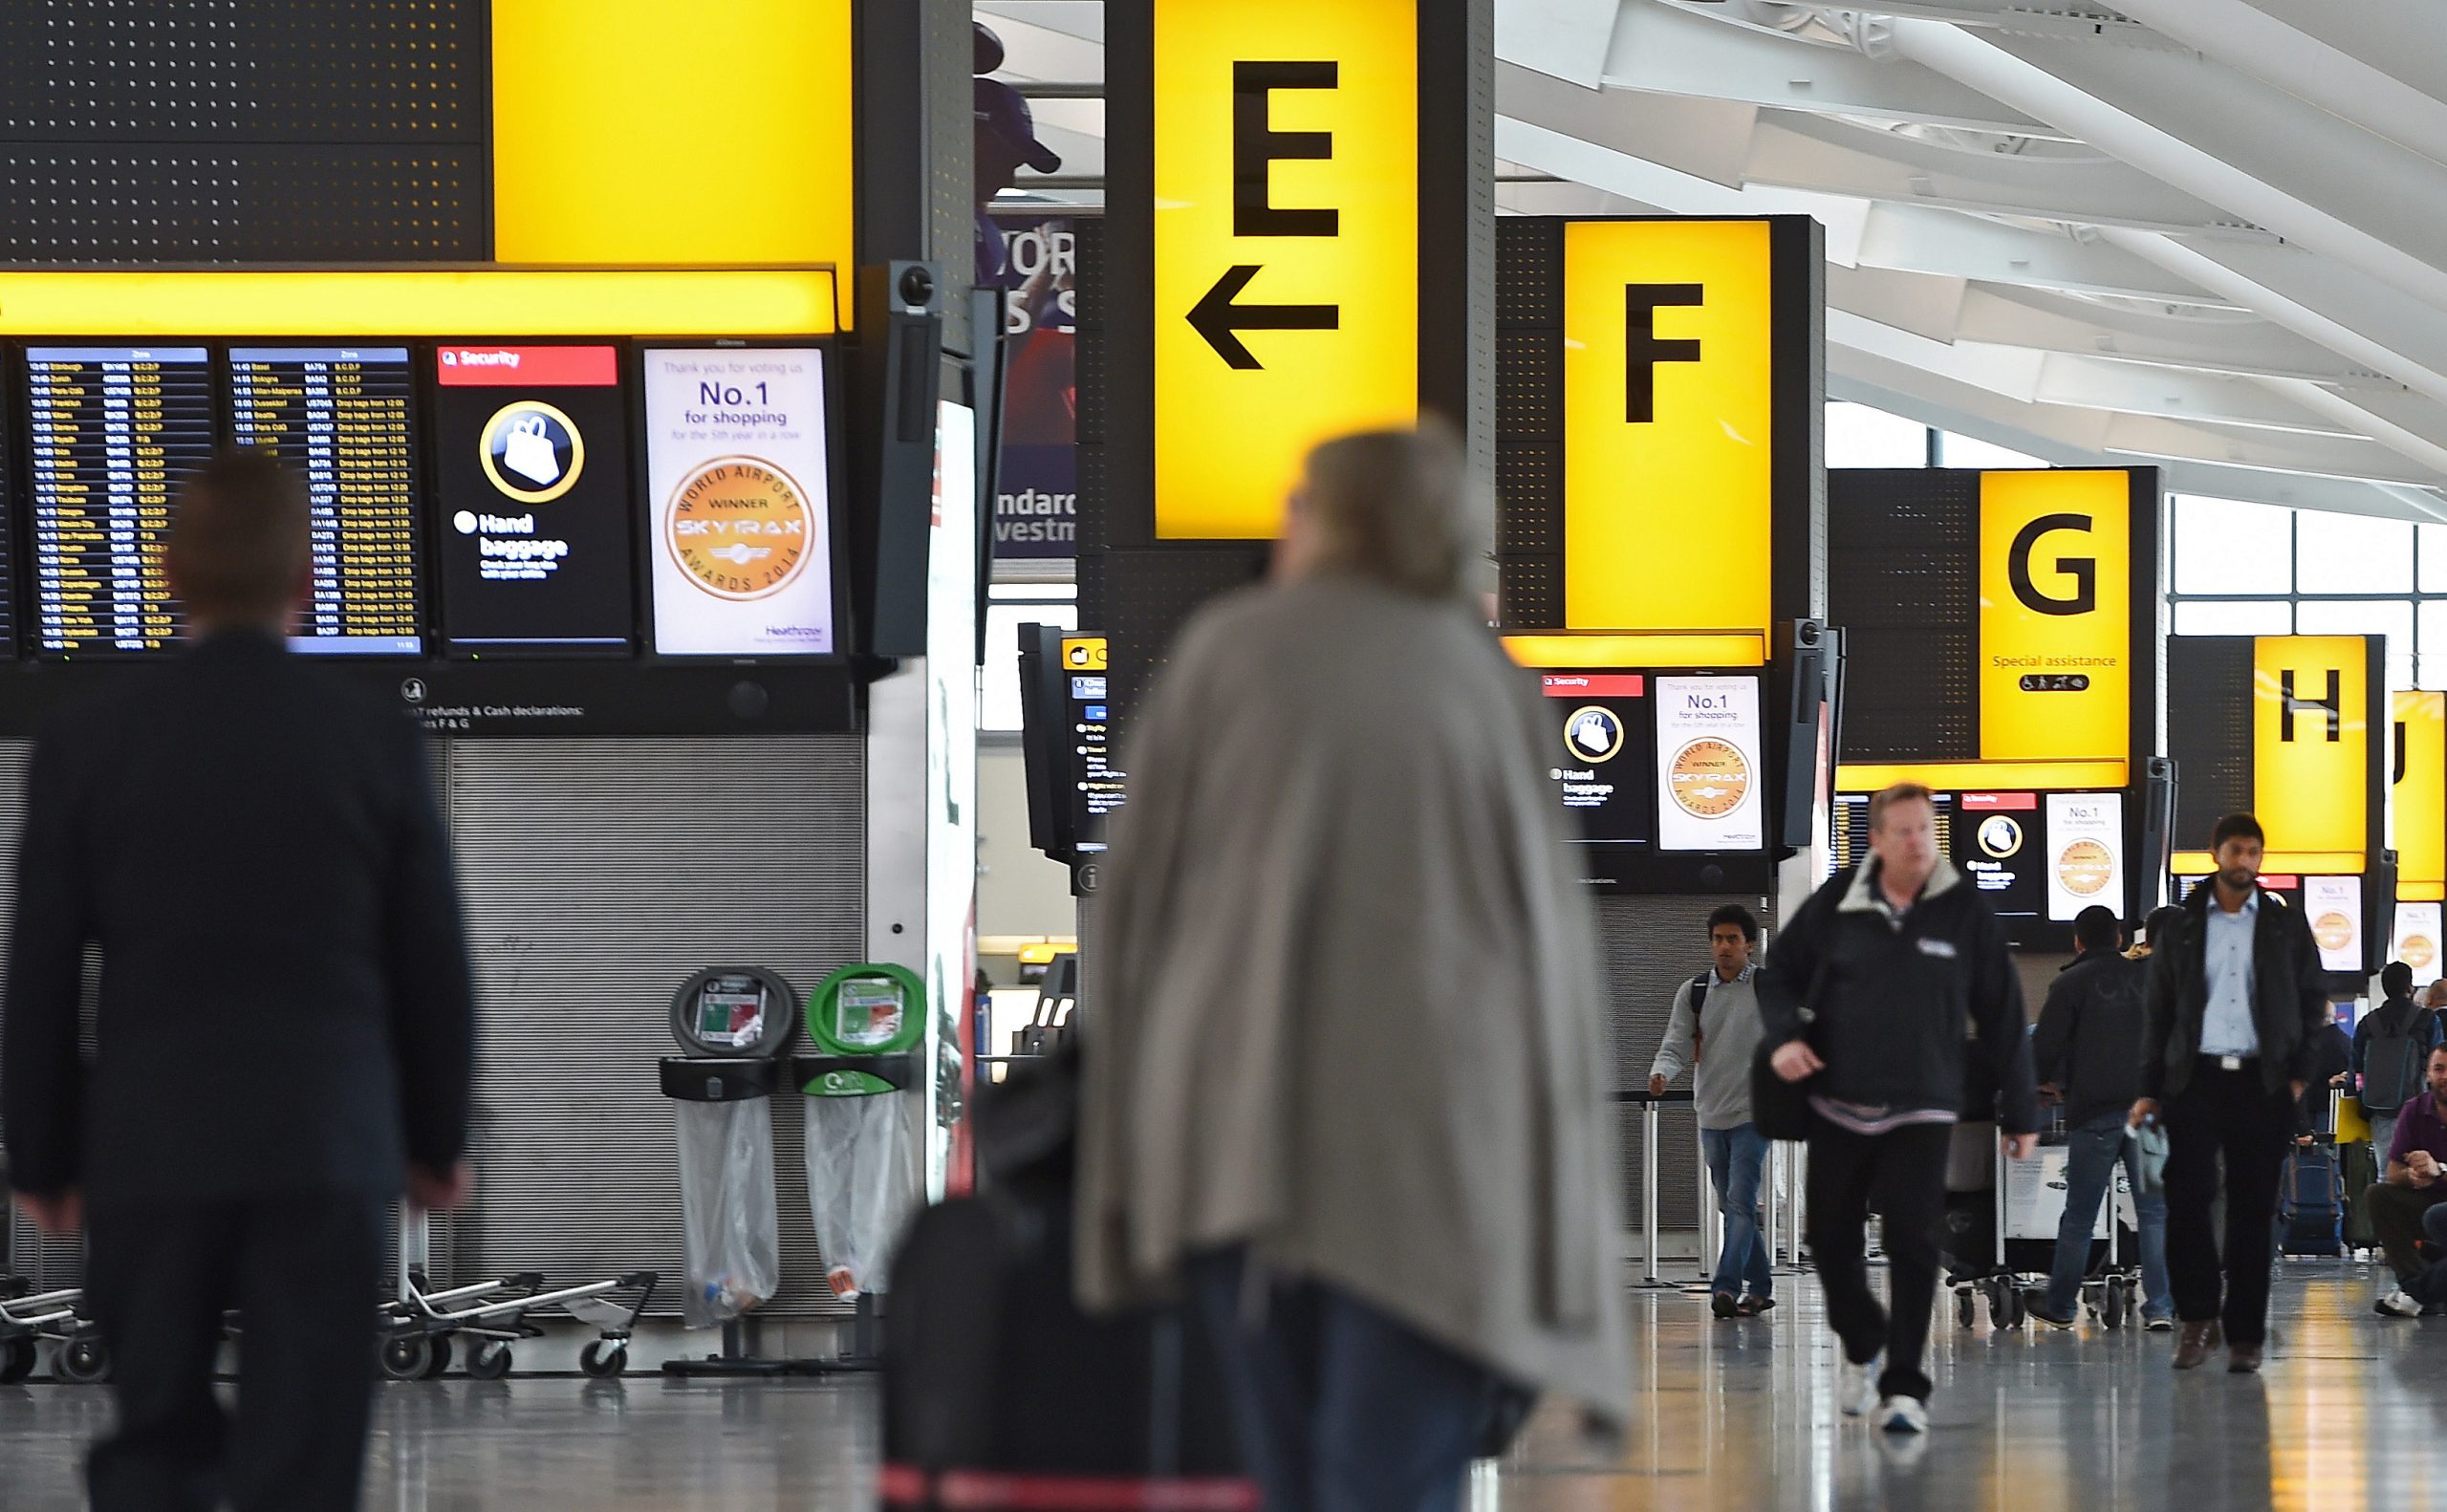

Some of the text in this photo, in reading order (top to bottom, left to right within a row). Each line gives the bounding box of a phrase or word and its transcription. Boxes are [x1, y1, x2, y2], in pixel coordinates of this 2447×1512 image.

[1233, 60, 1338, 237] E
[460, 351, 520, 369] Security
[1625, 283, 1704, 422] F
[664, 361, 698, 373] Thank
[704, 363, 725, 374] you
[729, 361, 746, 373] for
[749, 361, 786, 375] voting
[700, 380, 768, 405] No.1
[685, 410, 788, 426] for shopping
[679, 464, 800, 512] WORLD AIRPORT
[708, 499, 769, 509] WINNER
[479, 513, 534, 533] Hand
[675, 519, 803, 535] SKYTRAX
[480, 536, 569, 560] baggage
[681, 548, 799, 592] AWARDS 2014
[2008, 513, 2096, 616] G
[1993, 655, 2117, 669] Special assistance
[1553, 678, 1589, 686] Security
[484, 705, 511, 717] Cash
[2281, 669, 2340, 742] H
[1563, 769, 1594, 780] Hand
